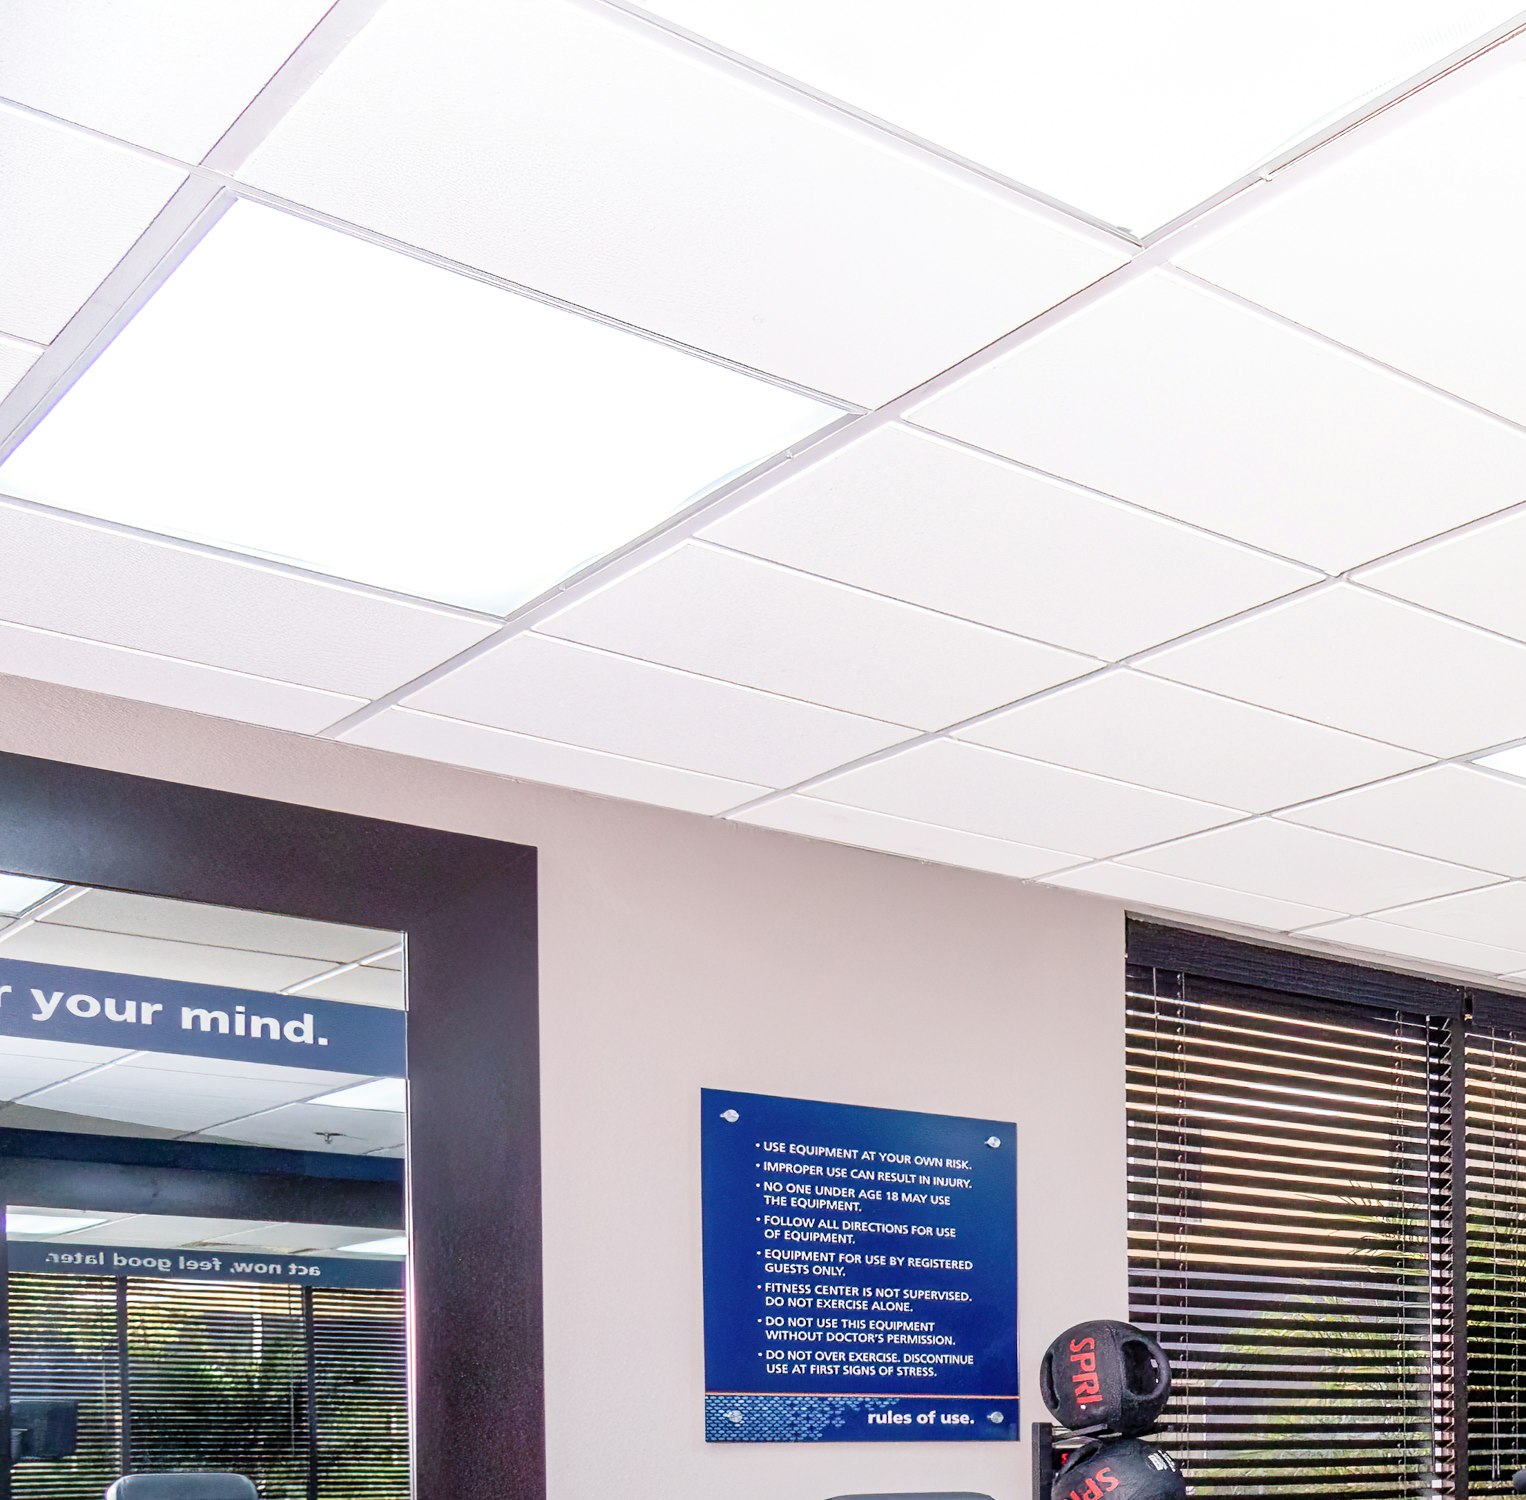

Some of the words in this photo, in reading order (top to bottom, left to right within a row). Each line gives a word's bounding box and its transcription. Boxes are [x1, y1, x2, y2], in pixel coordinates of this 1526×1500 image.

[30, 988, 163, 1025] your
[181, 1005, 329, 1046] mind.
[763, 1141, 786, 1152] USE
[788, 1143, 859, 1159] EQUIPMENT
[860, 1151, 877, 1160] AT
[877, 1152, 912, 1163] YOUR
[913, 1155, 943, 1167] OWN
[944, 1158, 972, 1169] RISK.
[763, 1161, 824, 1175] IMPROPER
[825, 1166, 848, 1177] USE
[849, 1169, 875, 1180] CAN
[876, 1171, 917, 1183] RESULT
[918, 1175, 931, 1184] IN
[931, 1176, 972, 1188] INJURY.
[763, 1181, 783, 1191] NO
[784, 1183, 812, 1194] ONE
[814, 1185, 856, 1197] UNDER
[857, 1189, 882, 1200] AGE
[885, 1191, 899, 1201] 18
[900, 1192, 928, 1203] MAY
[929, 1195, 951, 1205] USE
[763, 1195, 787, 1206] THE
[789, 1197, 862, 1211] EQUIPMENT.
[763, 1215, 816, 1227] FOLLOW
[816, 1219, 840, 1229] ALL
[841, 1220, 909, 1234] DIRECTIONS
[910, 1225, 934, 1235] FOR
[935, 1227, 956, 1237] USE
[763, 1228, 781, 1238] OF
[783, 1230, 856, 1243] EQUIPMENT.
[764, 1248, 836, 1261] EQUIPMENT
[837, 1253, 862, 1263] FOR
[864, 1254, 887, 1265] USE
[888, 1256, 905, 1265] BY
[906, 1257, 973, 1269] REGISTERED
[764, 1262, 810, 1274] GUESTS
[811, 1265, 846, 1276] ONLY.
[764, 1282, 812, 1294] FITNESS
[813, 1284, 860, 1296] CENTER
[861, 1287, 873, 1296] IS
[874, 1288, 901, 1298] NOT
[901, 1289, 972, 1301] SUPERVISED.
[765, 1296, 785, 1306] DO
[786, 1297, 814, 1307] NOT
[815, 1298, 869, 1309] EXERCISE
[870, 1301, 913, 1311] ALONE.
[765, 1316, 785, 1326] DO
[786, 1317, 814, 1327] NOT
[815, 1318, 838, 1328] USE
[839, 1318, 867, 1329] THIS
[868, 1320, 935, 1331] EQUIPMENT
[765, 1330, 824, 1341] WITHOUT
[825, 1331, 884, 1343] DOCTOR'S
[886, 1333, 956, 1345] PERMISSION.
[765, 1349, 785, 1359] DO
[786, 1350, 813, 1360] NOT
[813, 1351, 846, 1361] OVER
[847, 1352, 901, 1362] EXERCISE.
[902, 1353, 974, 1364] DISCONTINUE
[766, 1363, 789, 1373] USE
[790, 1364, 807, 1373] AT
[809, 1364, 841, 1374] FIRST
[841, 1364, 876, 1375] SIGNS
[877, 1365, 894, 1375] OF
[895, 1366, 937, 1376] STRESS.
[867, 1410, 912, 1424] rules
[916, 1410, 937, 1424] of
[940, 1413, 975, 1424] use.
